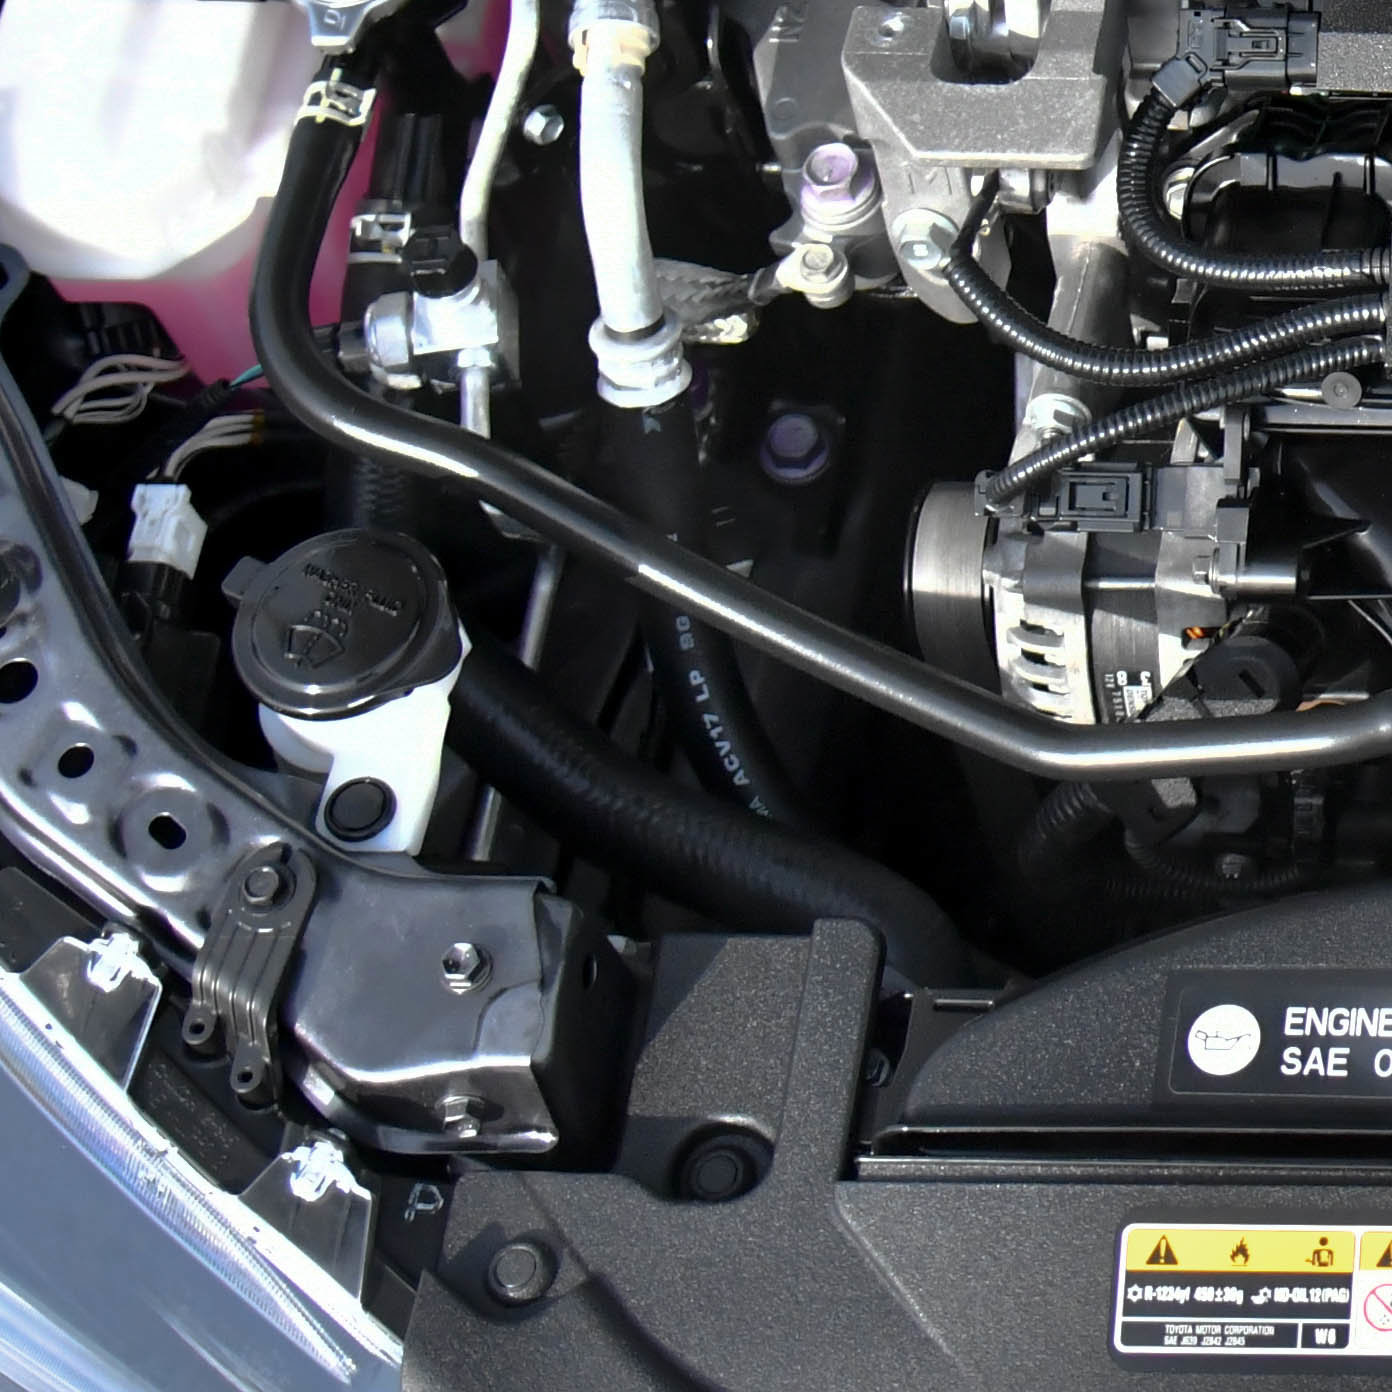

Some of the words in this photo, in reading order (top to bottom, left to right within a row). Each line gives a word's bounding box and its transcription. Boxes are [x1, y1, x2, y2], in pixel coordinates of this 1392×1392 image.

[687, 668, 712, 703] LP
[702, 711, 751, 787] ACV17
[1279, 1046, 1351, 1078] SAE
[1163, 1335, 1178, 1346] SAE
[1165, 1324, 1193, 1335] TOYOTA
[1195, 1324, 1222, 1335] MOTOR
[1224, 1324, 1276, 1336] CORPORATION
